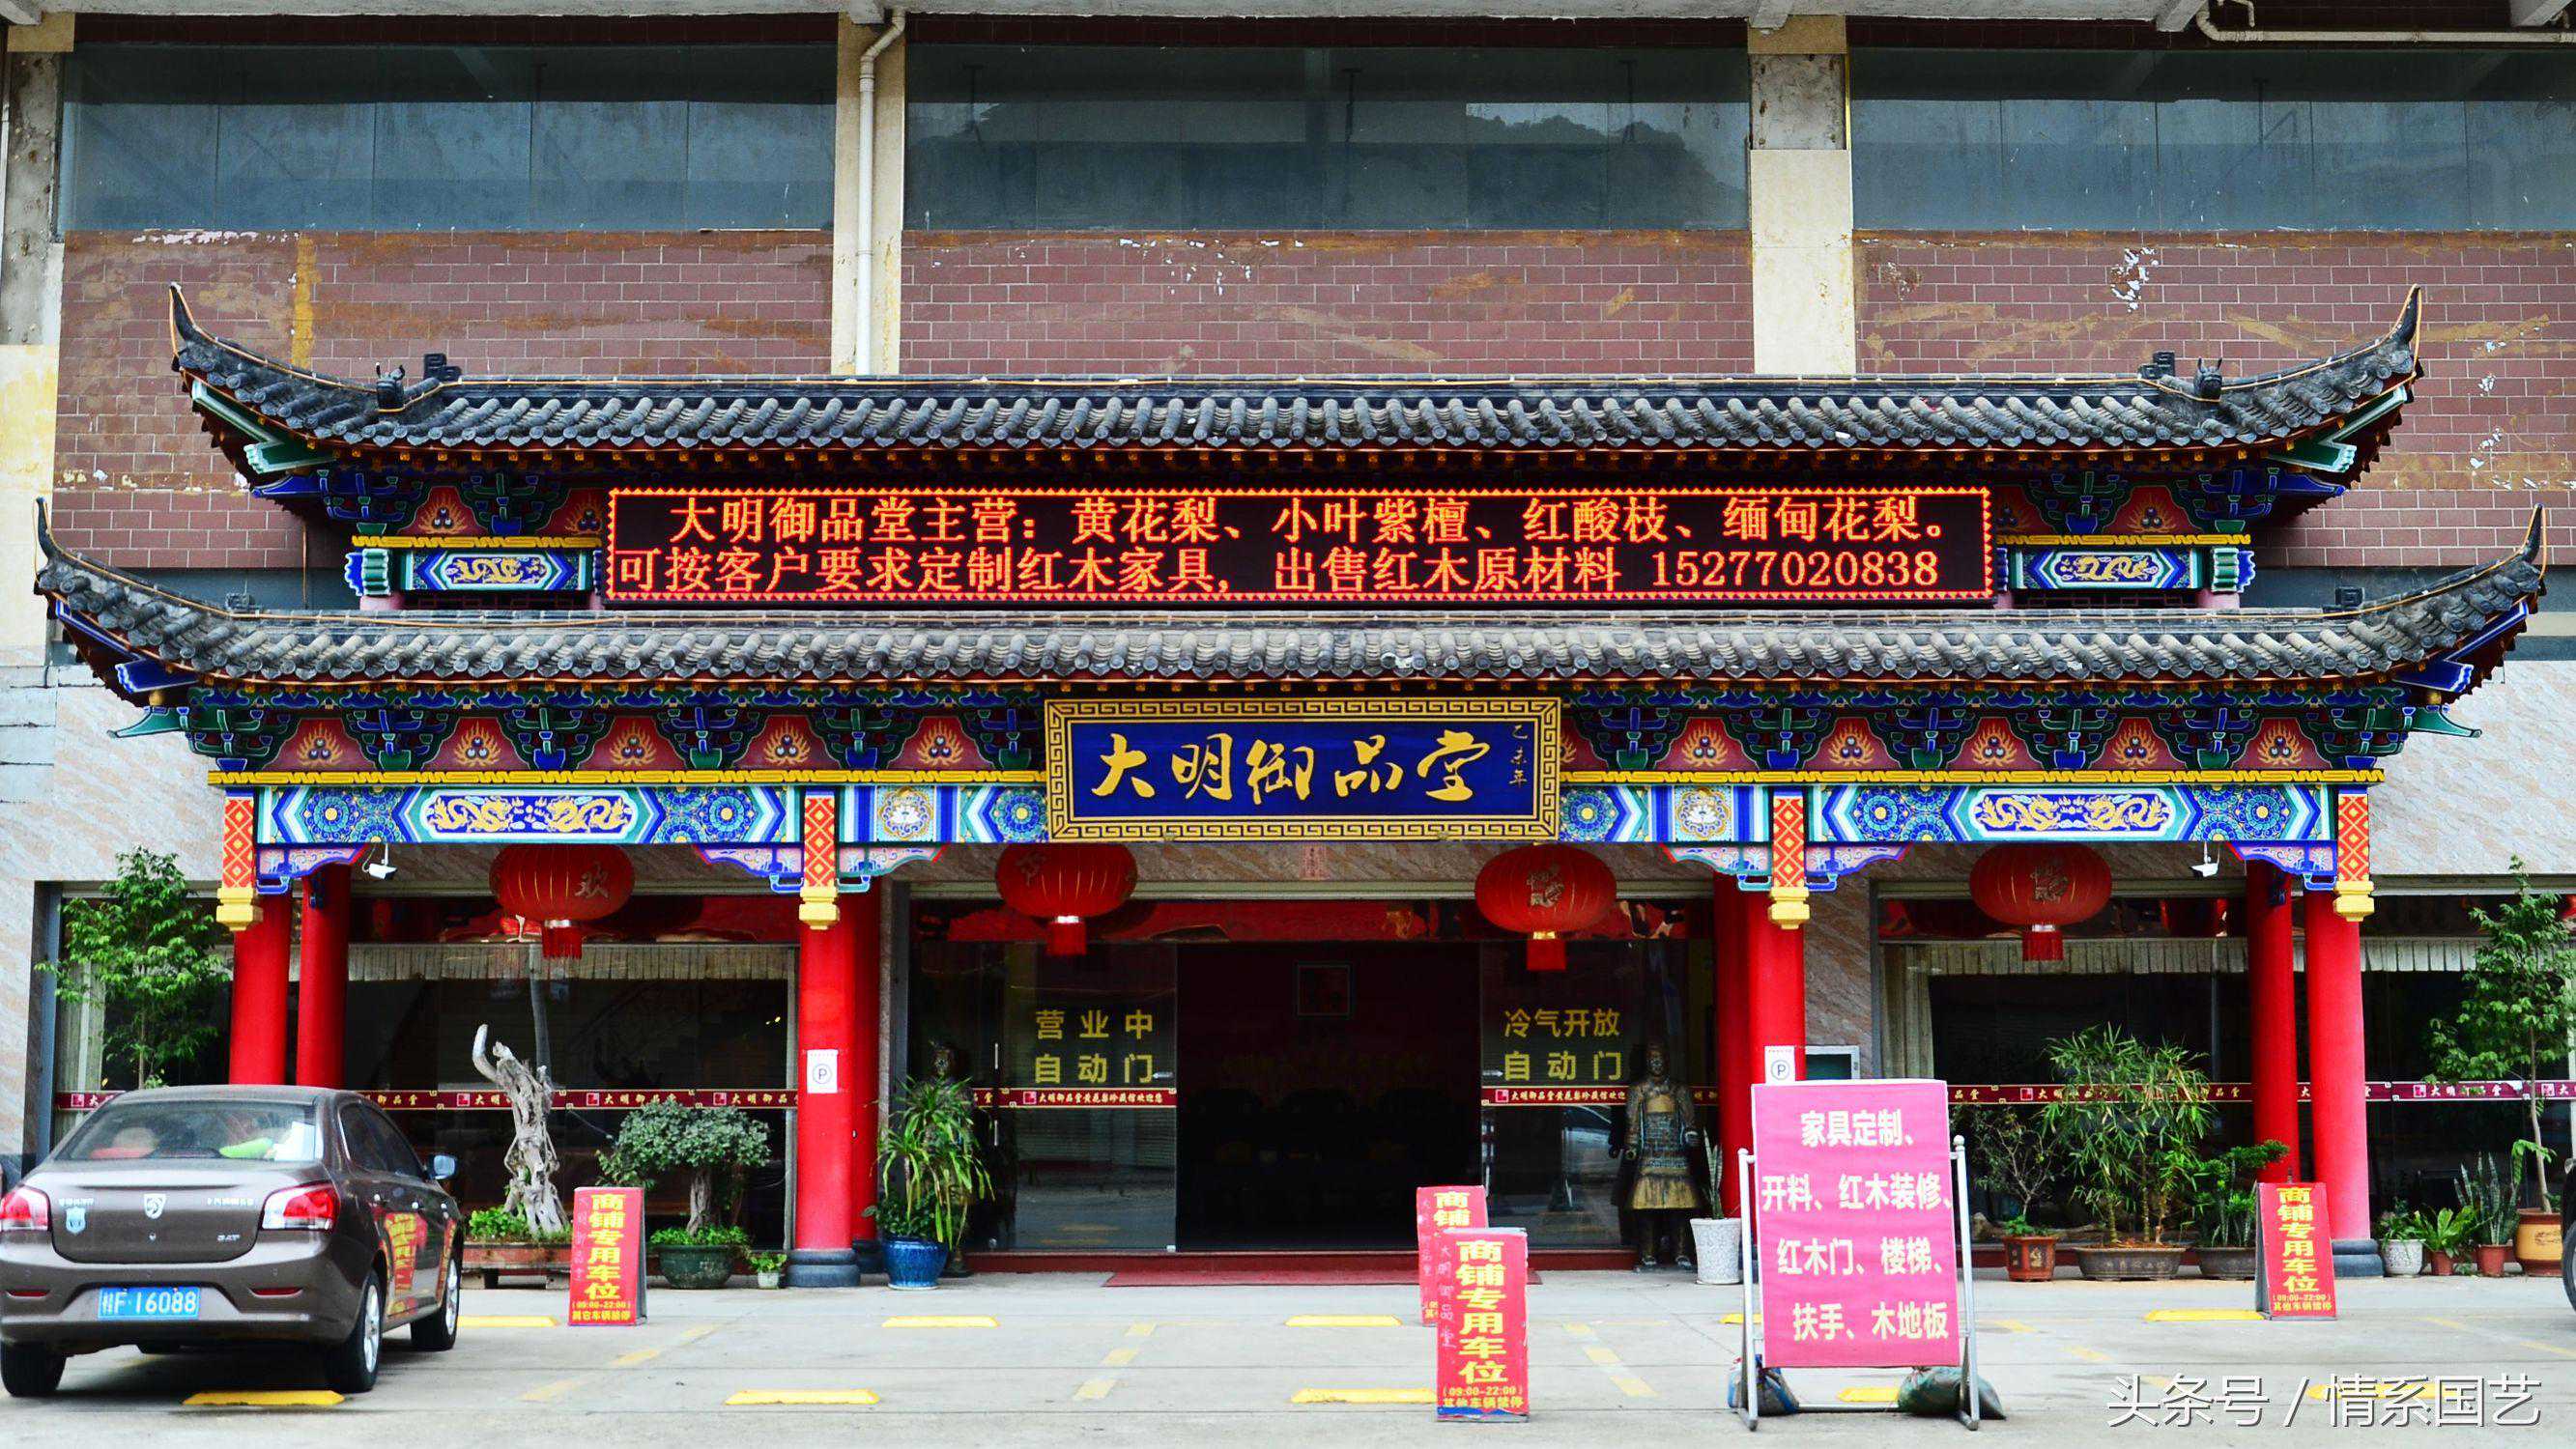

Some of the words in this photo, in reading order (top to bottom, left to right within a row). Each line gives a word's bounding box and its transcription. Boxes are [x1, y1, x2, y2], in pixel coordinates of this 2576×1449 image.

[1651, 551, 1938, 586] 15277020838
[1091, 729, 1491, 805] 大明御品堂
[1035, 1009, 1154, 1040] 营业中
[1503, 1008, 1621, 1038] 冷气开放
[1034, 1053, 1154, 1084] 自动门
[1503, 1050, 1623, 1082] 自动门
[731, 1092, 798, 1105] 大明御品
[1800, 1109, 1913, 1147] 家具定制、
[1433, 1190, 1471, 1237] 商铺
[583, 1193, 627, 1300] 商铺专用车位
[2275, 1186, 2320, 1294] 商铺专用车位
[1455, 1238, 1509, 1384] 商铺专用车位
